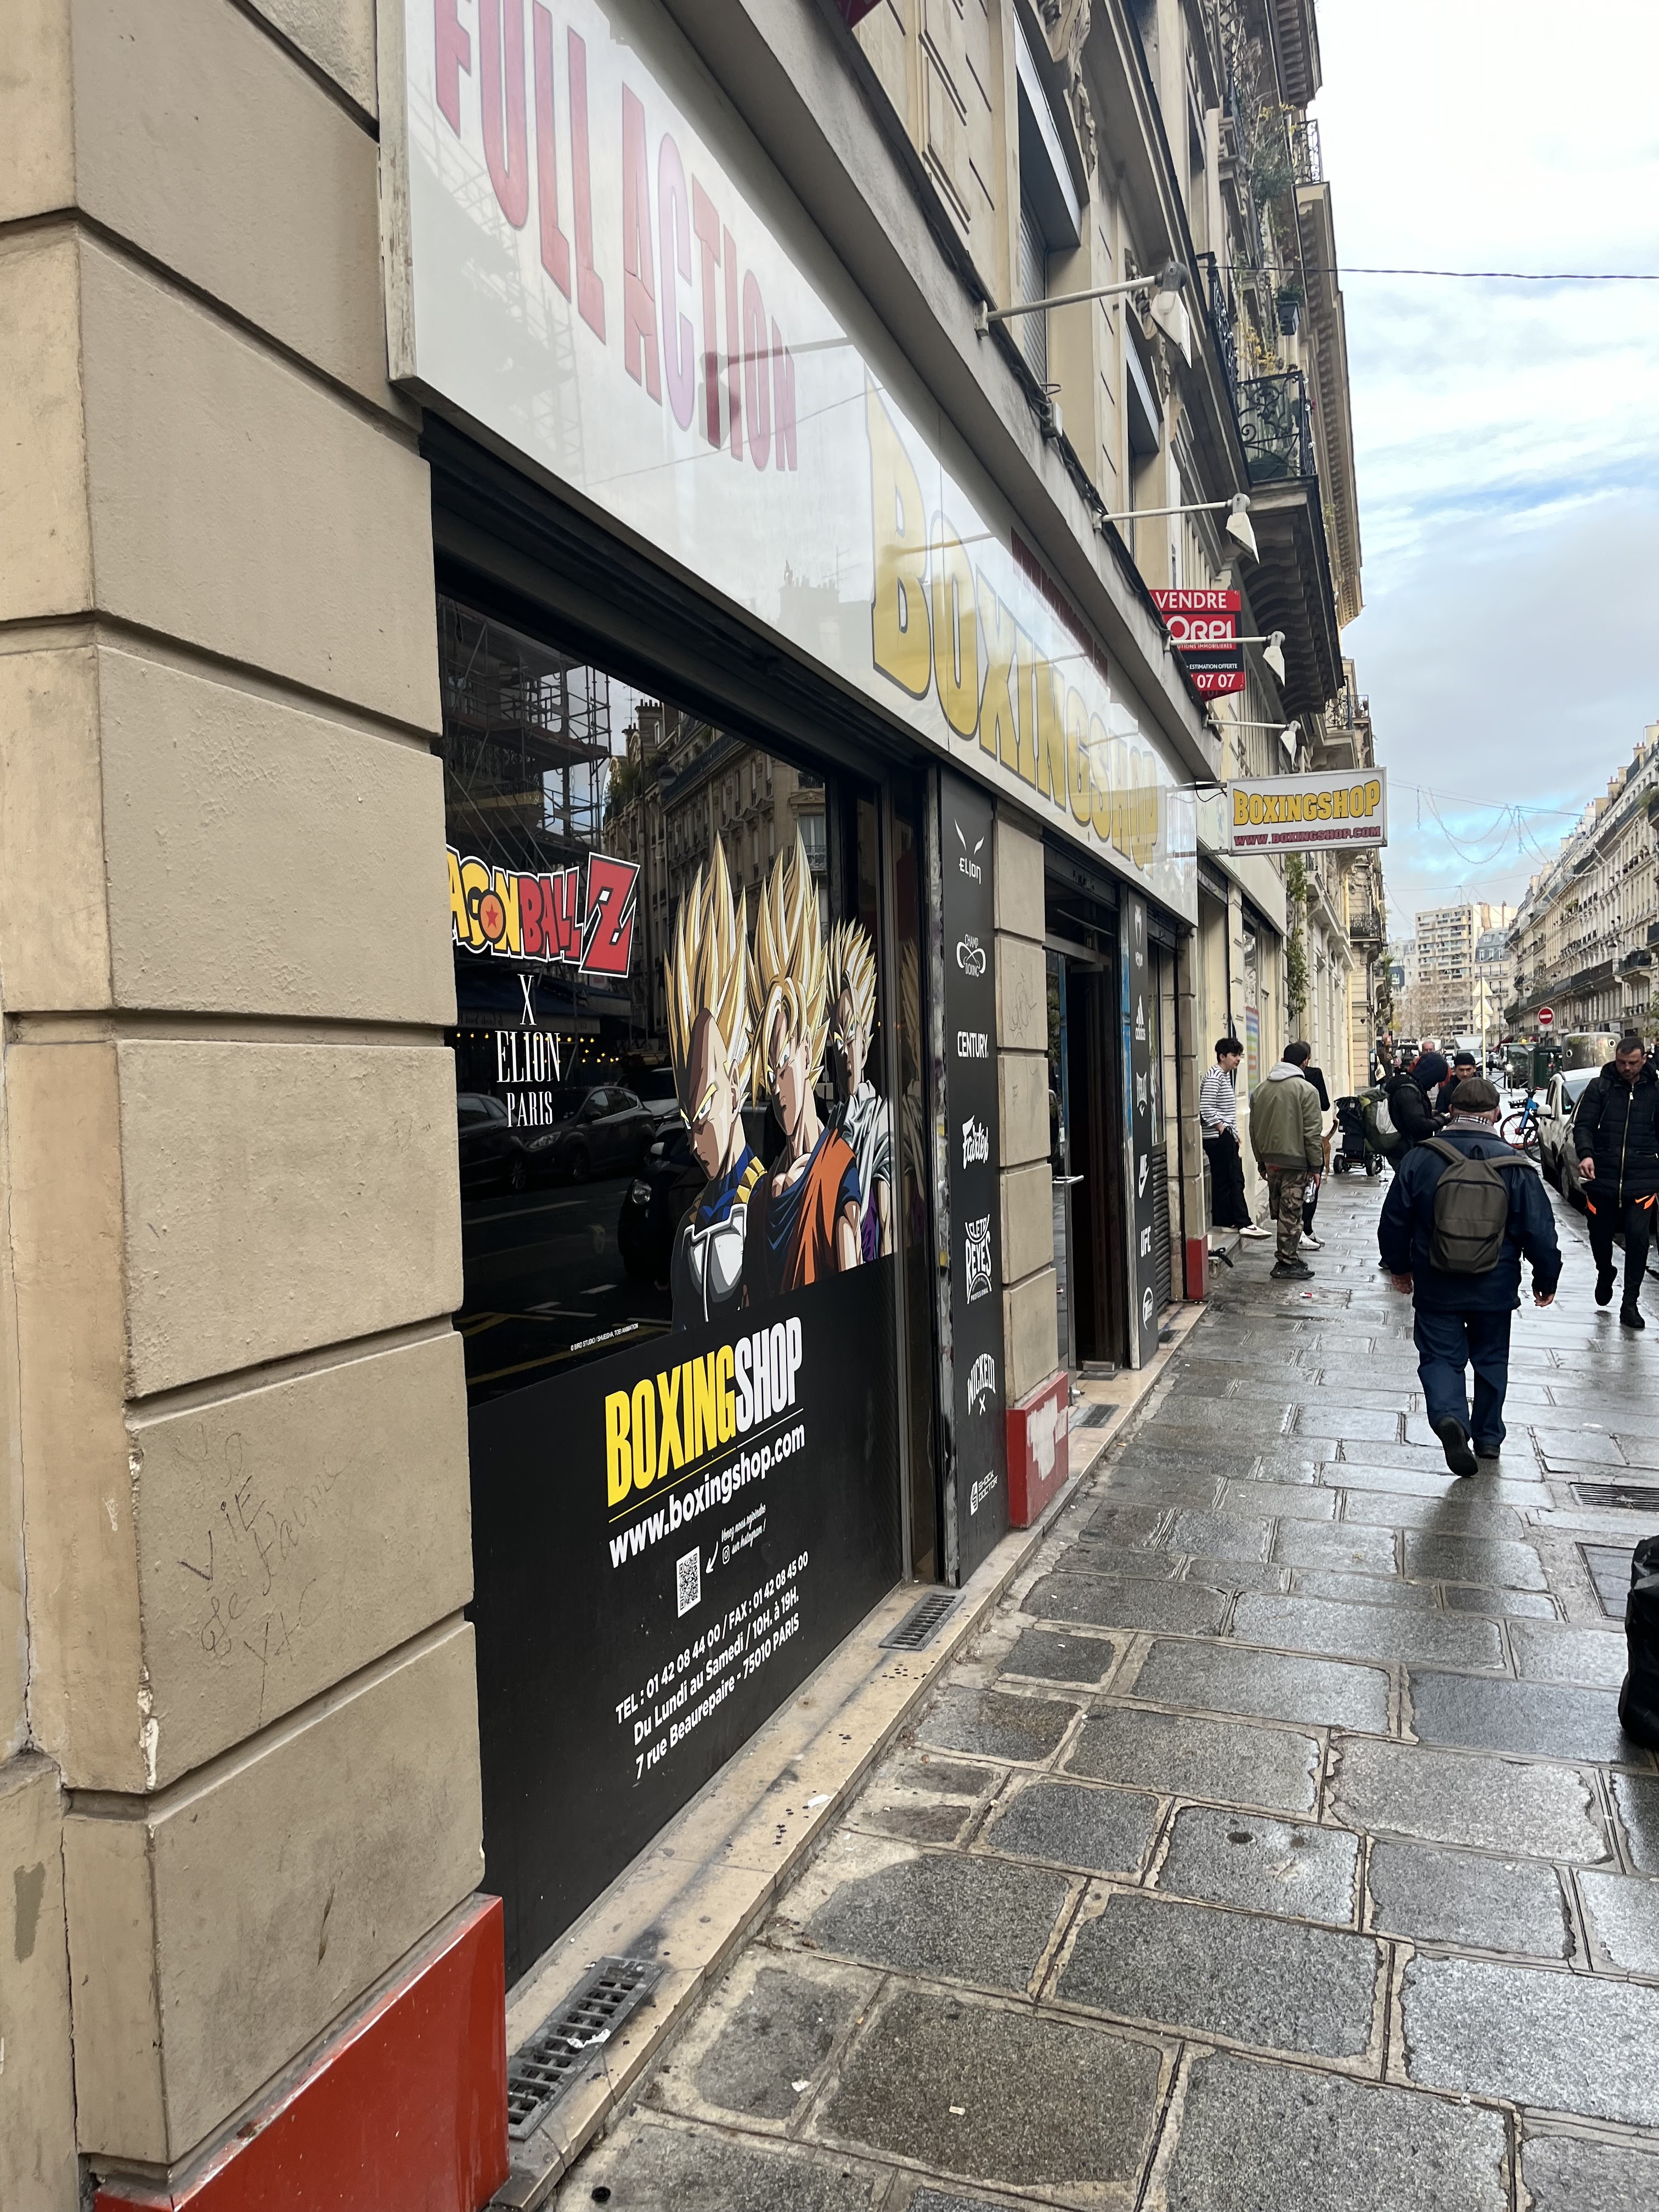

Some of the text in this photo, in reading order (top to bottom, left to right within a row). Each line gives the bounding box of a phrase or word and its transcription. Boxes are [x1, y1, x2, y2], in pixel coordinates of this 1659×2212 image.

[434, 0, 798, 472] FULL ACTION
[864, 366, 1159, 881] BOXINGSHOP
[1155, 591, 1227, 609] VENDRE
[1166, 615, 1232, 640] ORPI
[1197, 674, 1235, 689] 07 07
[1233, 779, 1381, 826] BOXINGSHOP
[1233, 826, 1381, 846] WWW.BOXINGSHOP.COM
[517, 973, 537, 1026] X
[494, 1030, 560, 1083] ELION
[506, 1090, 553, 1128] PARIS
[968, 1217, 988, 1239] CLETO
[1141, 1225, 1152, 1257] UFC
[965, 1230, 992, 1298] REYES
[605, 1316, 803, 1508] BOXINGSHOP
[609, 1424, 805, 1568] www.boxingshop.com
[616, 1693, 638, 1724] TEL
[646, 1673, 659, 1699] 01
[661, 1661, 675, 1685] 42
[677, 1649, 690, 1673] 08
[692, 1636, 706, 1659] 44
[707, 1623, 720, 1647] 00
[729, 1600, 748, 1630] FAX
[753, 1588, 763, 1609] 01
[764, 1579, 775, 1599] 42
[776, 1569, 786, 1590] 08
[787, 1559, 797, 1579] 45
[798, 1551, 809, 1571] 00
[634, 1715, 652, 1746] Du
[654, 1679, 688, 1728] Lundi
[690, 1671, 704, 1696] au
[706, 1631, 744, 1681] Samedi
[752, 1609, 773, 1639] 10H.
[774, 1600, 780, 1621] à
[781, 1585, 799, 1614] 19H.
[635, 1753, 645, 1780] 7
[646, 1737, 667, 1770] rue
[670, 1675, 735, 1748] Beaurepaire
[742, 1638, 771, 1680] 75010
[773, 1612, 800, 1651] PARIS
